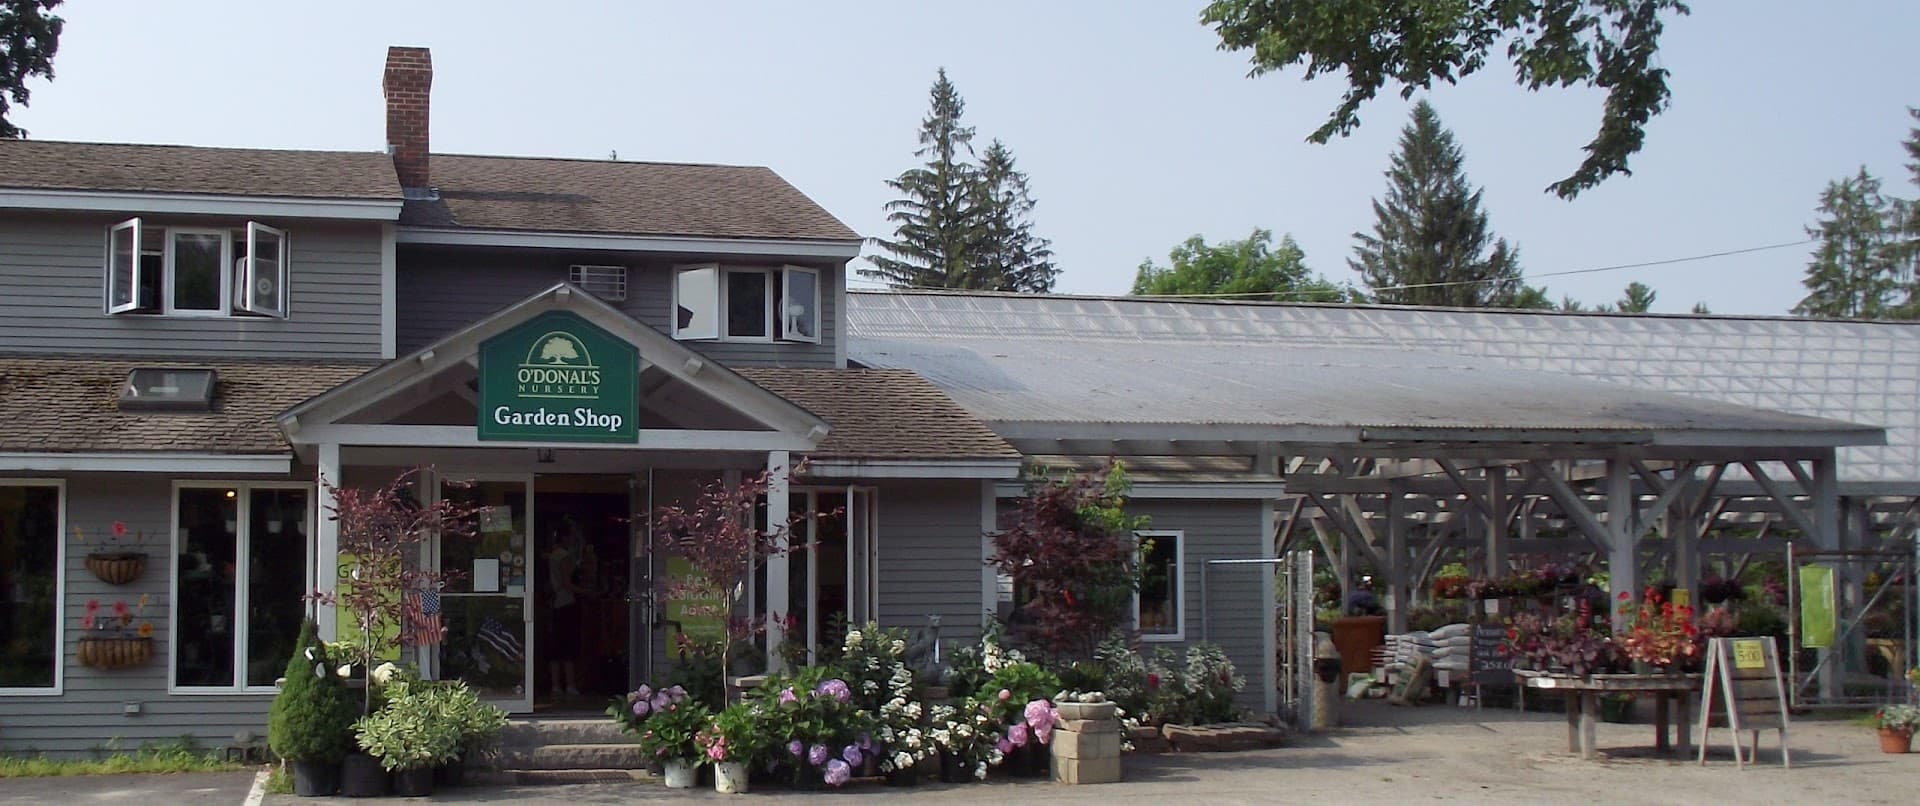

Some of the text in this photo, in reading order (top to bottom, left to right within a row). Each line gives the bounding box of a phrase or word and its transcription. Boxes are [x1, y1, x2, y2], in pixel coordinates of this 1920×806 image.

[517, 368, 601, 385] O'DONAL'S
[518, 384, 600, 394] NURSERY
[494, 406, 622, 432] Garden Shop
